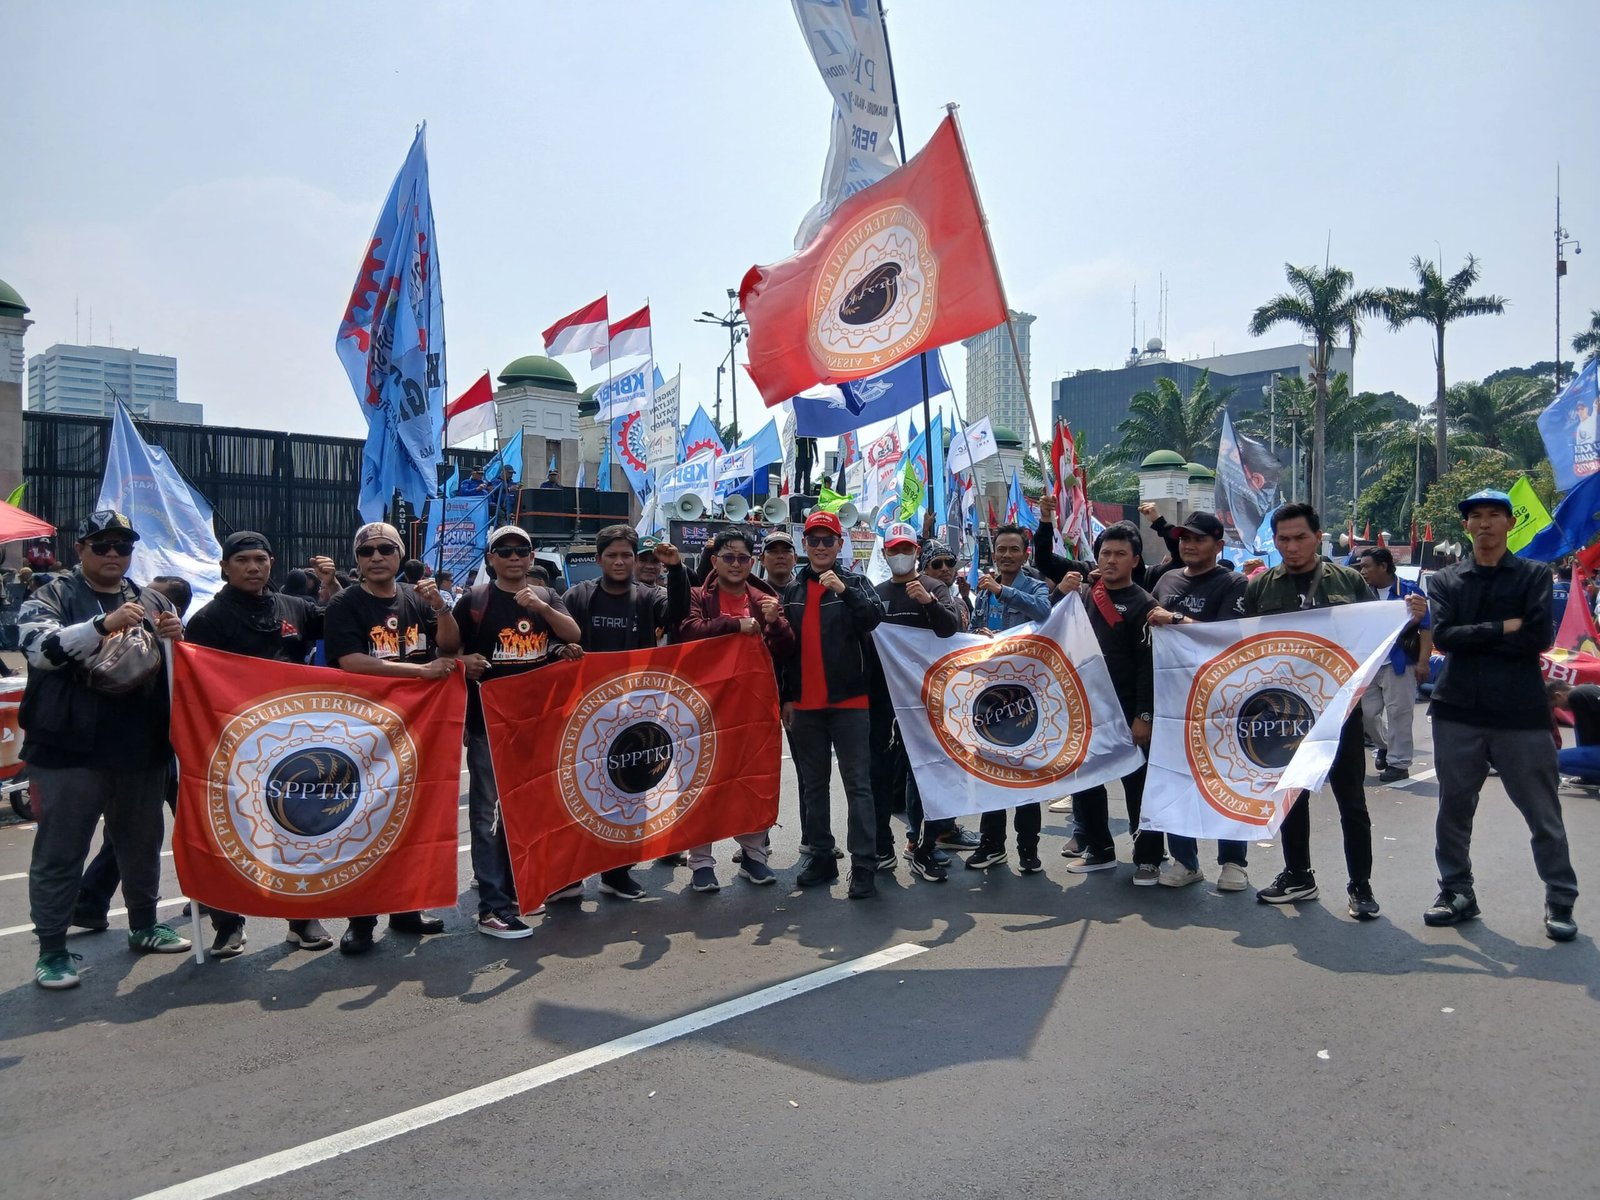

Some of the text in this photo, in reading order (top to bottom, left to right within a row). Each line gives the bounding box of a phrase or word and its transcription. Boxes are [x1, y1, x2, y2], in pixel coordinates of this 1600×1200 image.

[592, 616, 627, 628] ETARU
[1258, 642, 1335, 670] TERMINAL
[626, 676, 686, 697] TERMINAL
[1196, 649, 1256, 709] PELABUHAN
[565, 682, 624, 750] PELABUHAN
[974, 696, 1036, 728] SPPTKI
[1238, 719, 1312, 738] SPPTKI
[609, 744, 672, 770] SPPTKI
[212, 698, 414, 890] SERIKAT PEKERJA PELABUHAN TERMINAL KENDARAAN INDONESIA
[268, 780, 359, 800] SPPTKI
[649, 772, 706, 831] INDONESIA
[1207, 778, 1250, 812] SERIKAT
[580, 812, 627, 839] SERIKAT
